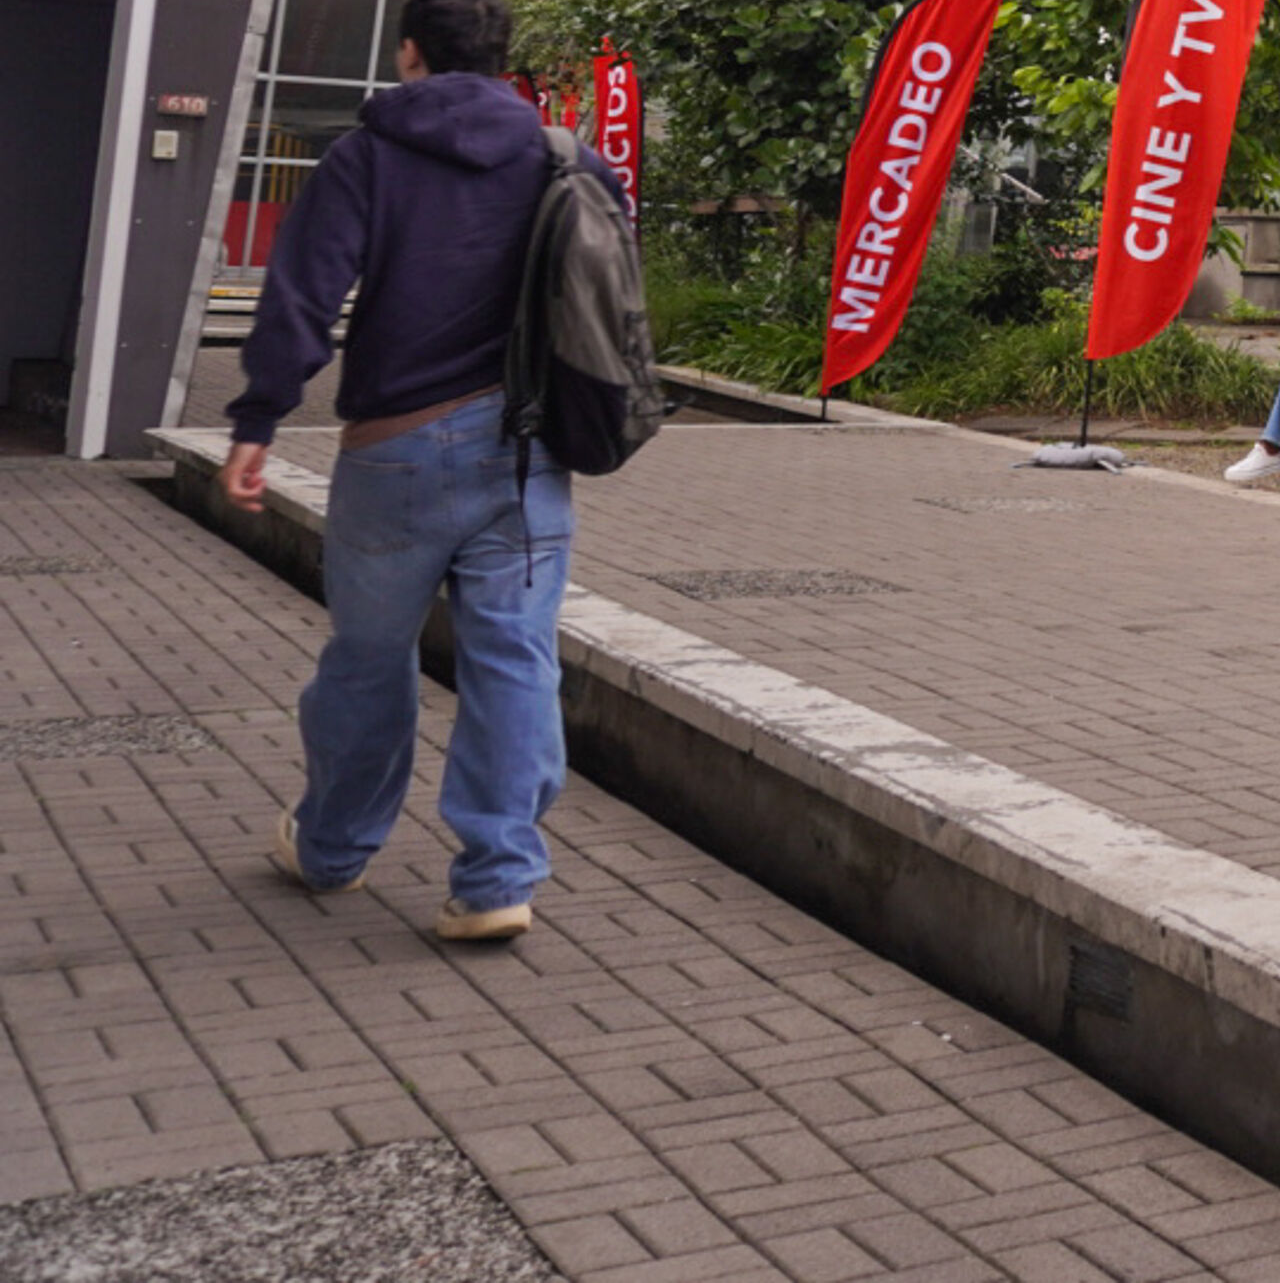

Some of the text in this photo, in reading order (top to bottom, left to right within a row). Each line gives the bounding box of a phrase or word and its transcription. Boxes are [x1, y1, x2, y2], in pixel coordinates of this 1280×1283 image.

[1157, 70, 1202, 108] Y
[831, 41, 952, 333] MERCADEO
[1124, 127, 1192, 262] CINE
